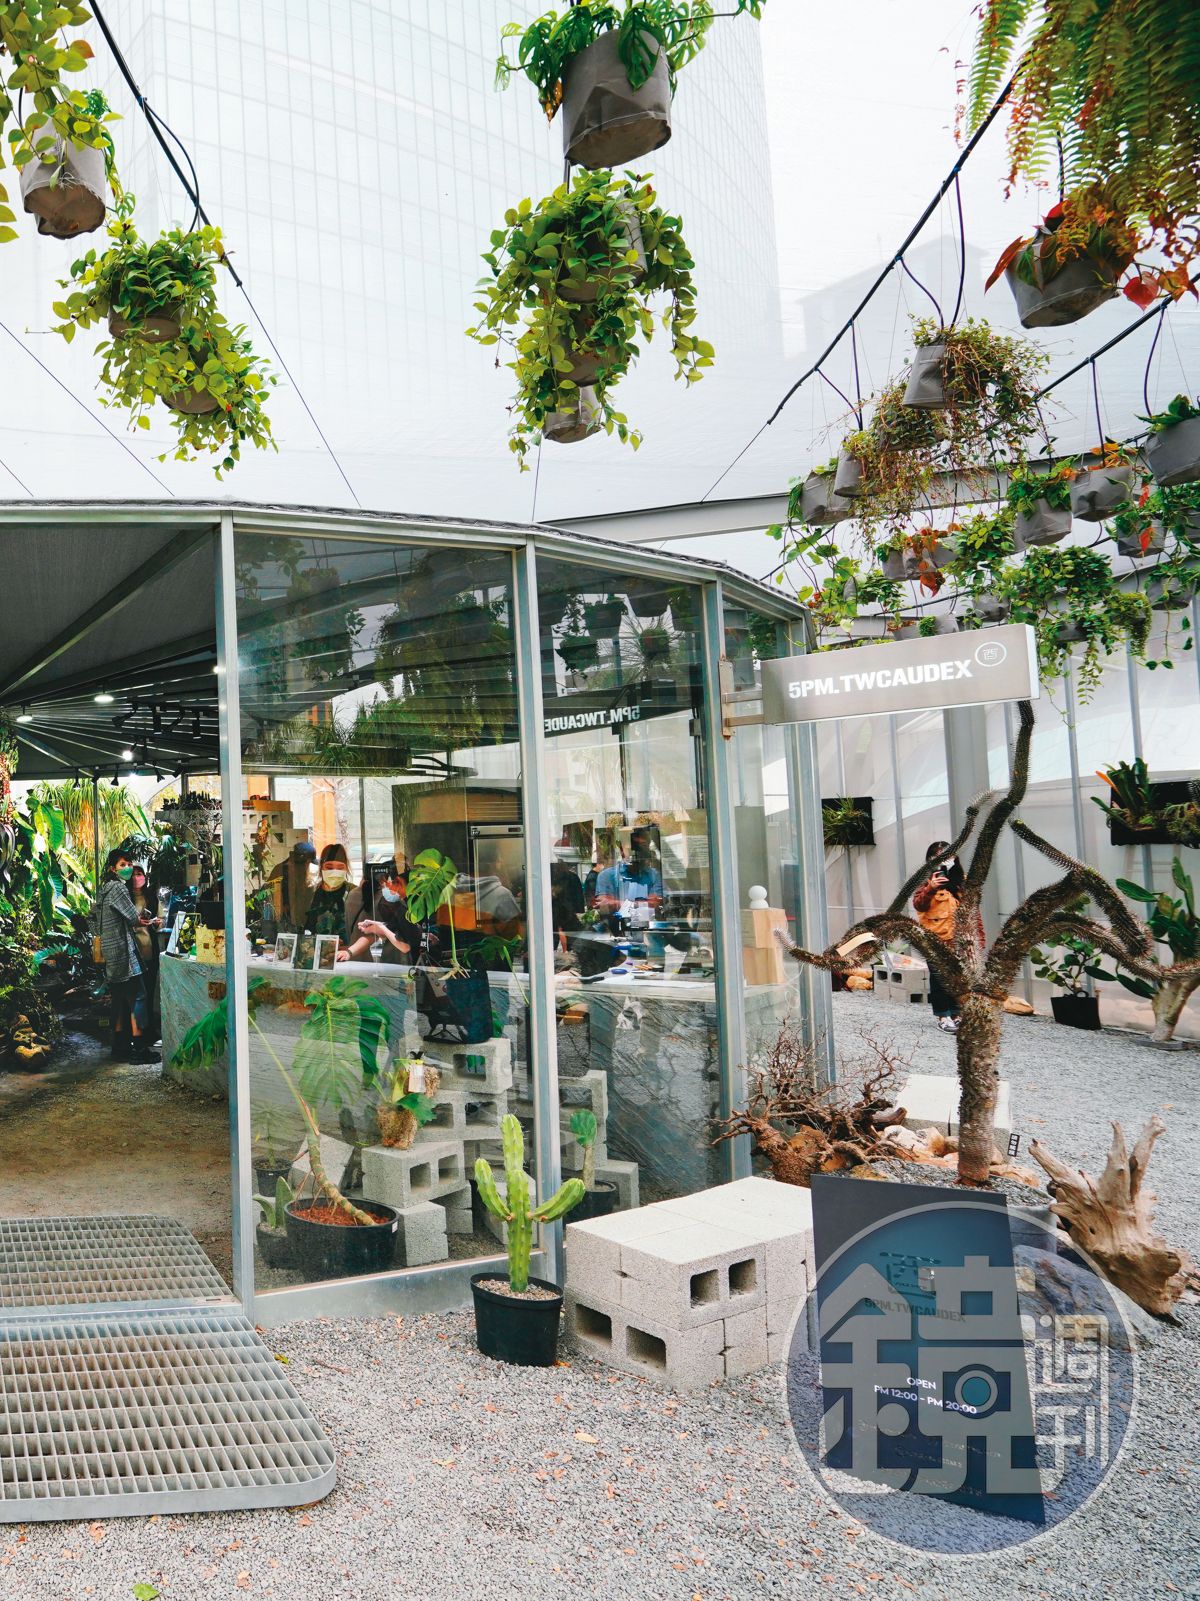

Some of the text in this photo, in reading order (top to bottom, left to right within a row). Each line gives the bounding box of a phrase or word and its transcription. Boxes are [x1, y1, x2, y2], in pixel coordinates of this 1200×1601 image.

[788, 659, 973, 700] 5PM.TWCAUDEX
[906, 1377, 937, 1390] OPEN
[874, 1385, 889, 1395] PM
[890, 1388, 918, 1401] 12:00
[927, 1396, 943, 1407] PM
[945, 1400, 978, 1414] 20:00
